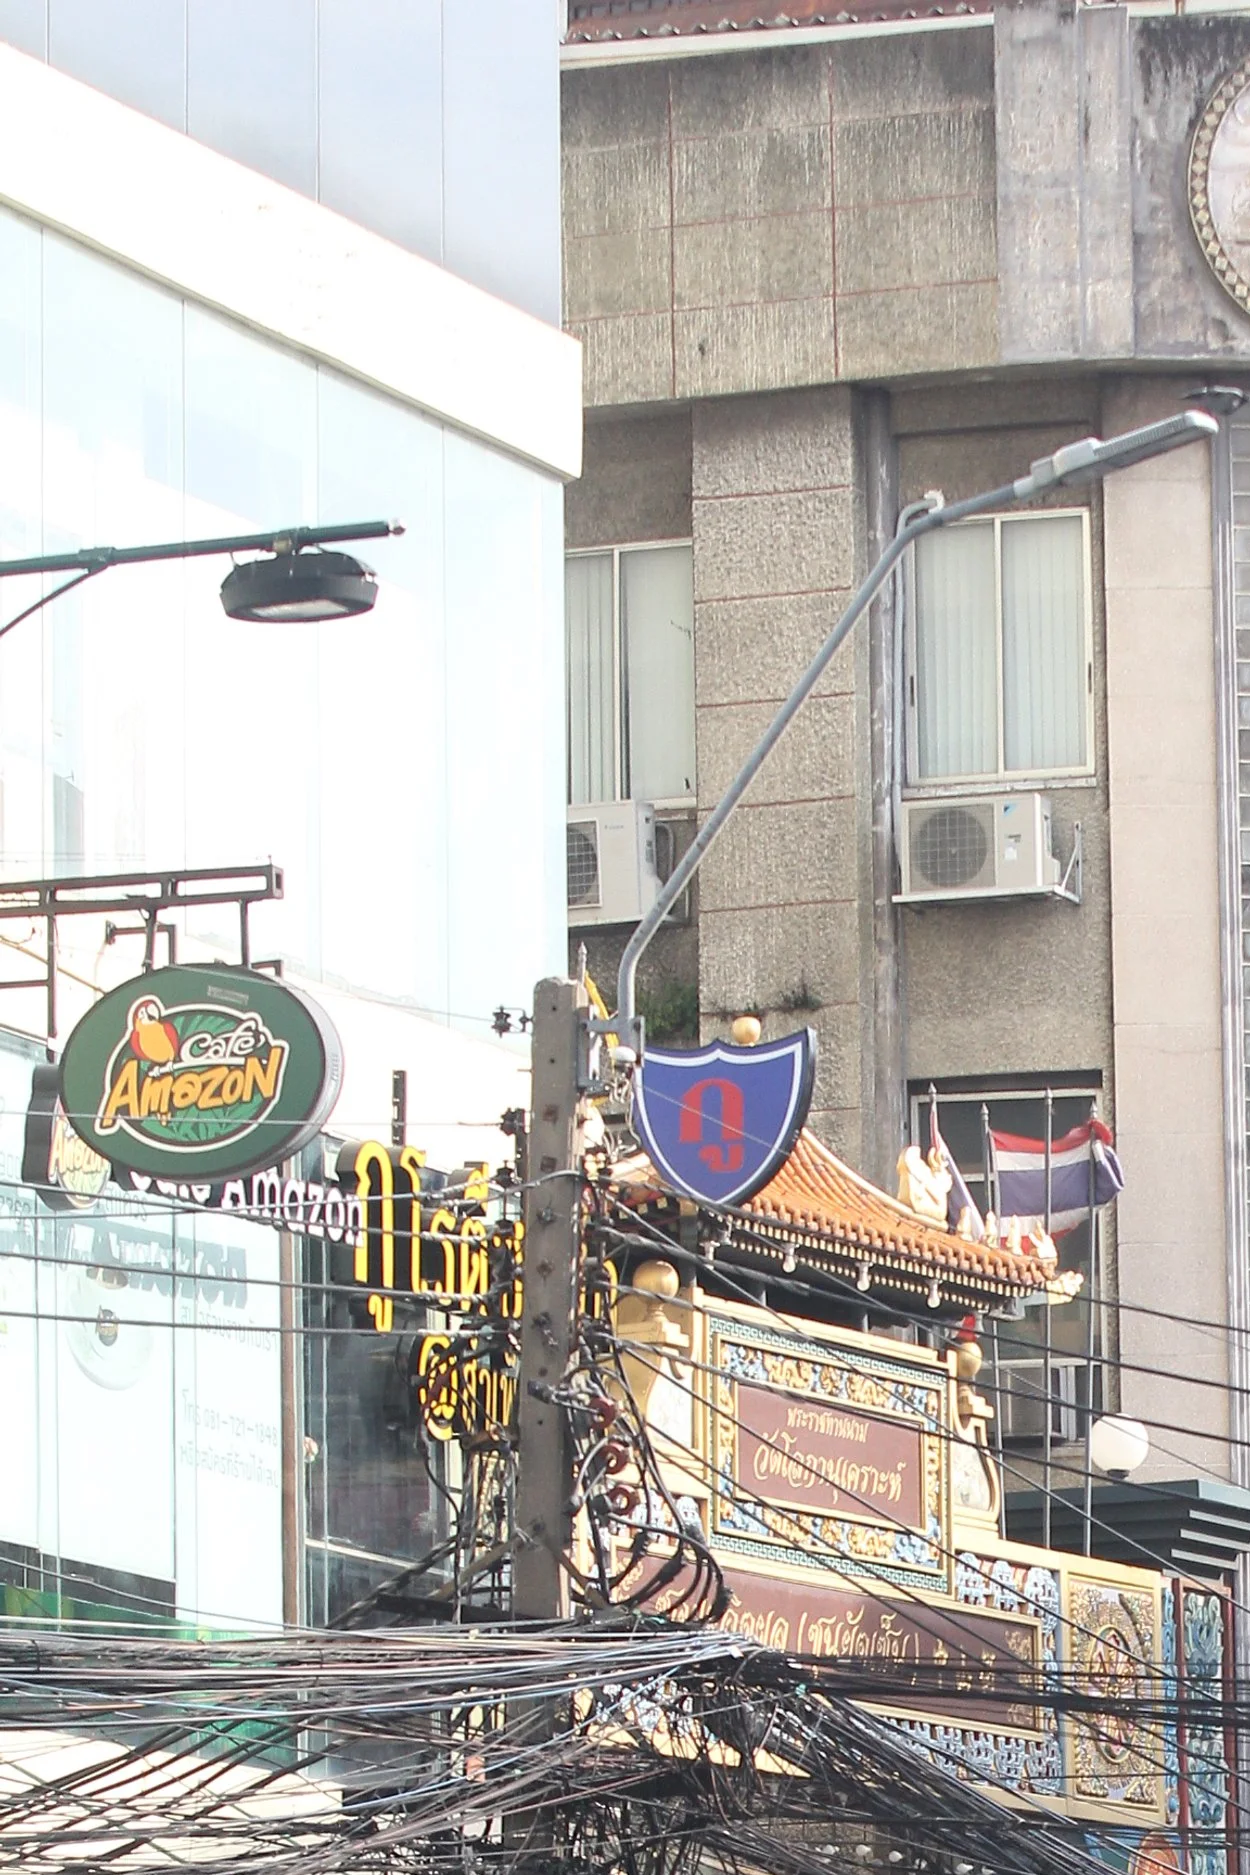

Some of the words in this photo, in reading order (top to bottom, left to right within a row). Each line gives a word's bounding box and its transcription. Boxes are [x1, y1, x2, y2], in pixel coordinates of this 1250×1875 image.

[680, 1078, 744, 1173] กู
[221, 1166, 365, 1249] Amazon
[753, 1428, 907, 1504] วัดโลกานุเคราะห์
